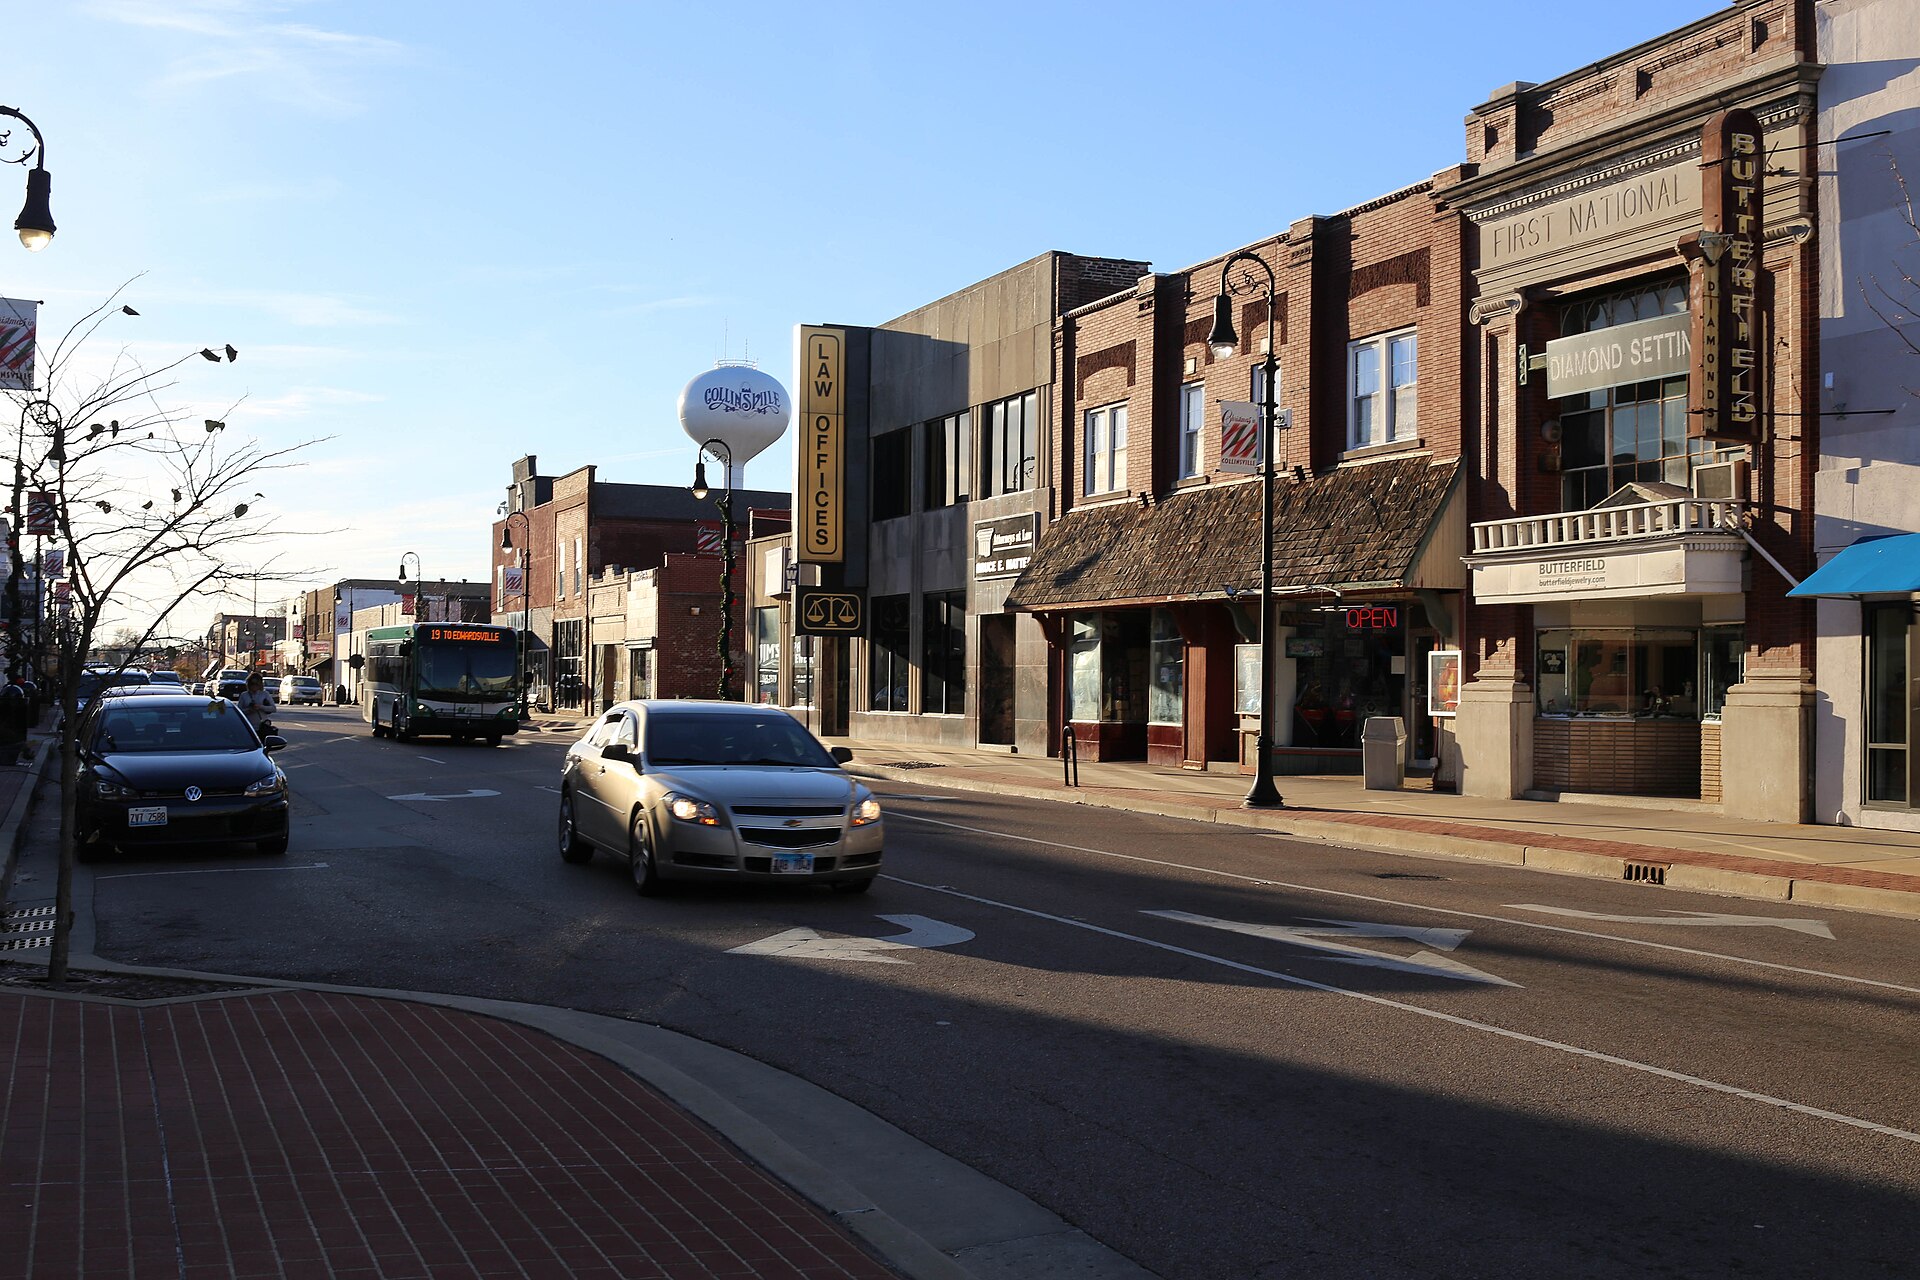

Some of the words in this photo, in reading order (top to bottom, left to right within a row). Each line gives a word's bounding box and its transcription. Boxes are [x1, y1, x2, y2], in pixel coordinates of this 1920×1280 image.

[1494, 212, 1554, 257] FIRST
[1569, 174, 1689, 236] NATIONAL
[1731, 132, 1756, 422] BUTTERFIELD
[1550, 343, 1623, 381] DIAMOND
[1706, 281, 1716, 417] DIAMONDS
[815, 343, 832, 397] LAW
[704, 386, 781, 414] COLLINSVILLE
[1221, 458, 1255, 466] COLLINSVILLE
[814, 415, 830, 545] OFFICES
[1539, 559, 1606, 575] BUTTERFIELD
[1539, 575, 1606, 588] butterfieldjewelry.com
[1347, 607, 1397, 628] OPEN
[431, 629, 441, 640] 19
[443, 630, 452, 640] TO
[453, 631, 500, 641] EDWARDSVILLE
